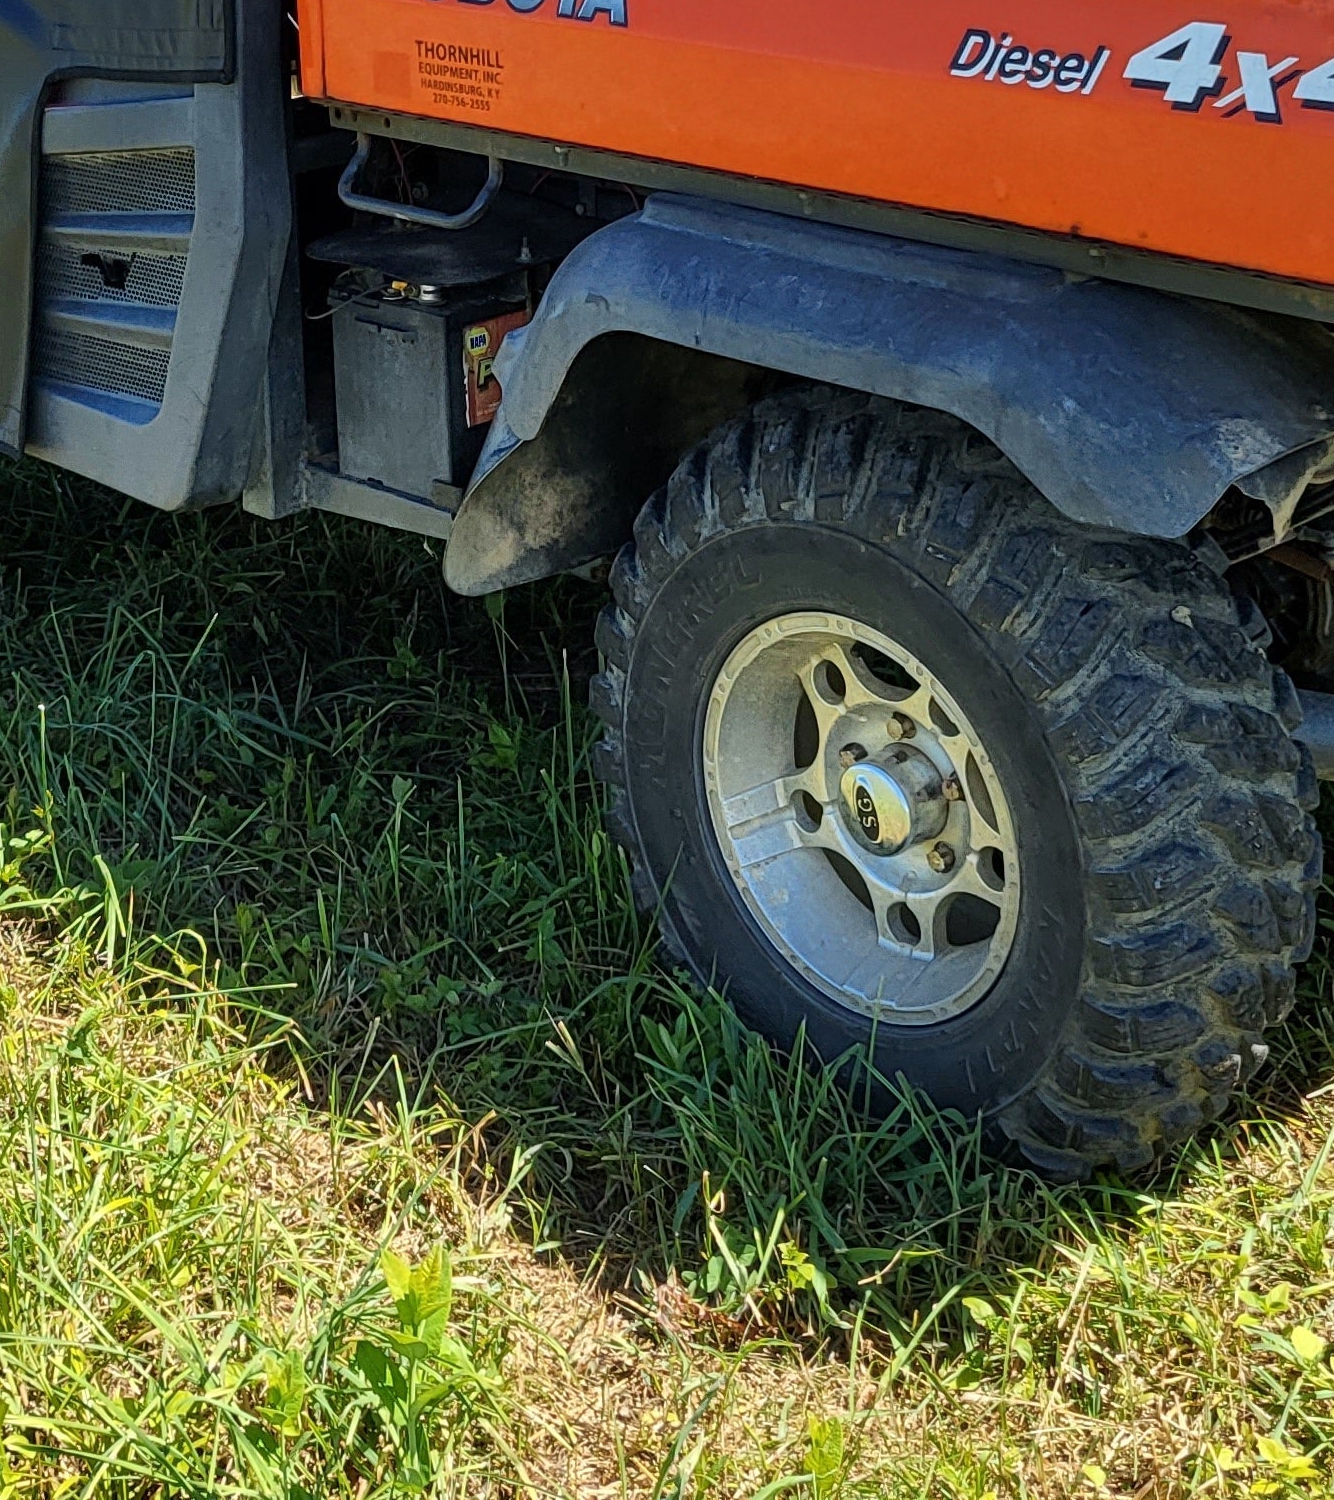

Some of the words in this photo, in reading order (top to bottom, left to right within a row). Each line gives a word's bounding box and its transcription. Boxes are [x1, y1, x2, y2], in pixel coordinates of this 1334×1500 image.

[414, 40, 504, 69] THORNHILL
[949, 28, 1110, 95] Diesel
[420, 78, 485, 99] HARDINSBURG,
[432, 93, 491, 111] 270-756-2555
[470, 334, 487, 350] NAPA
